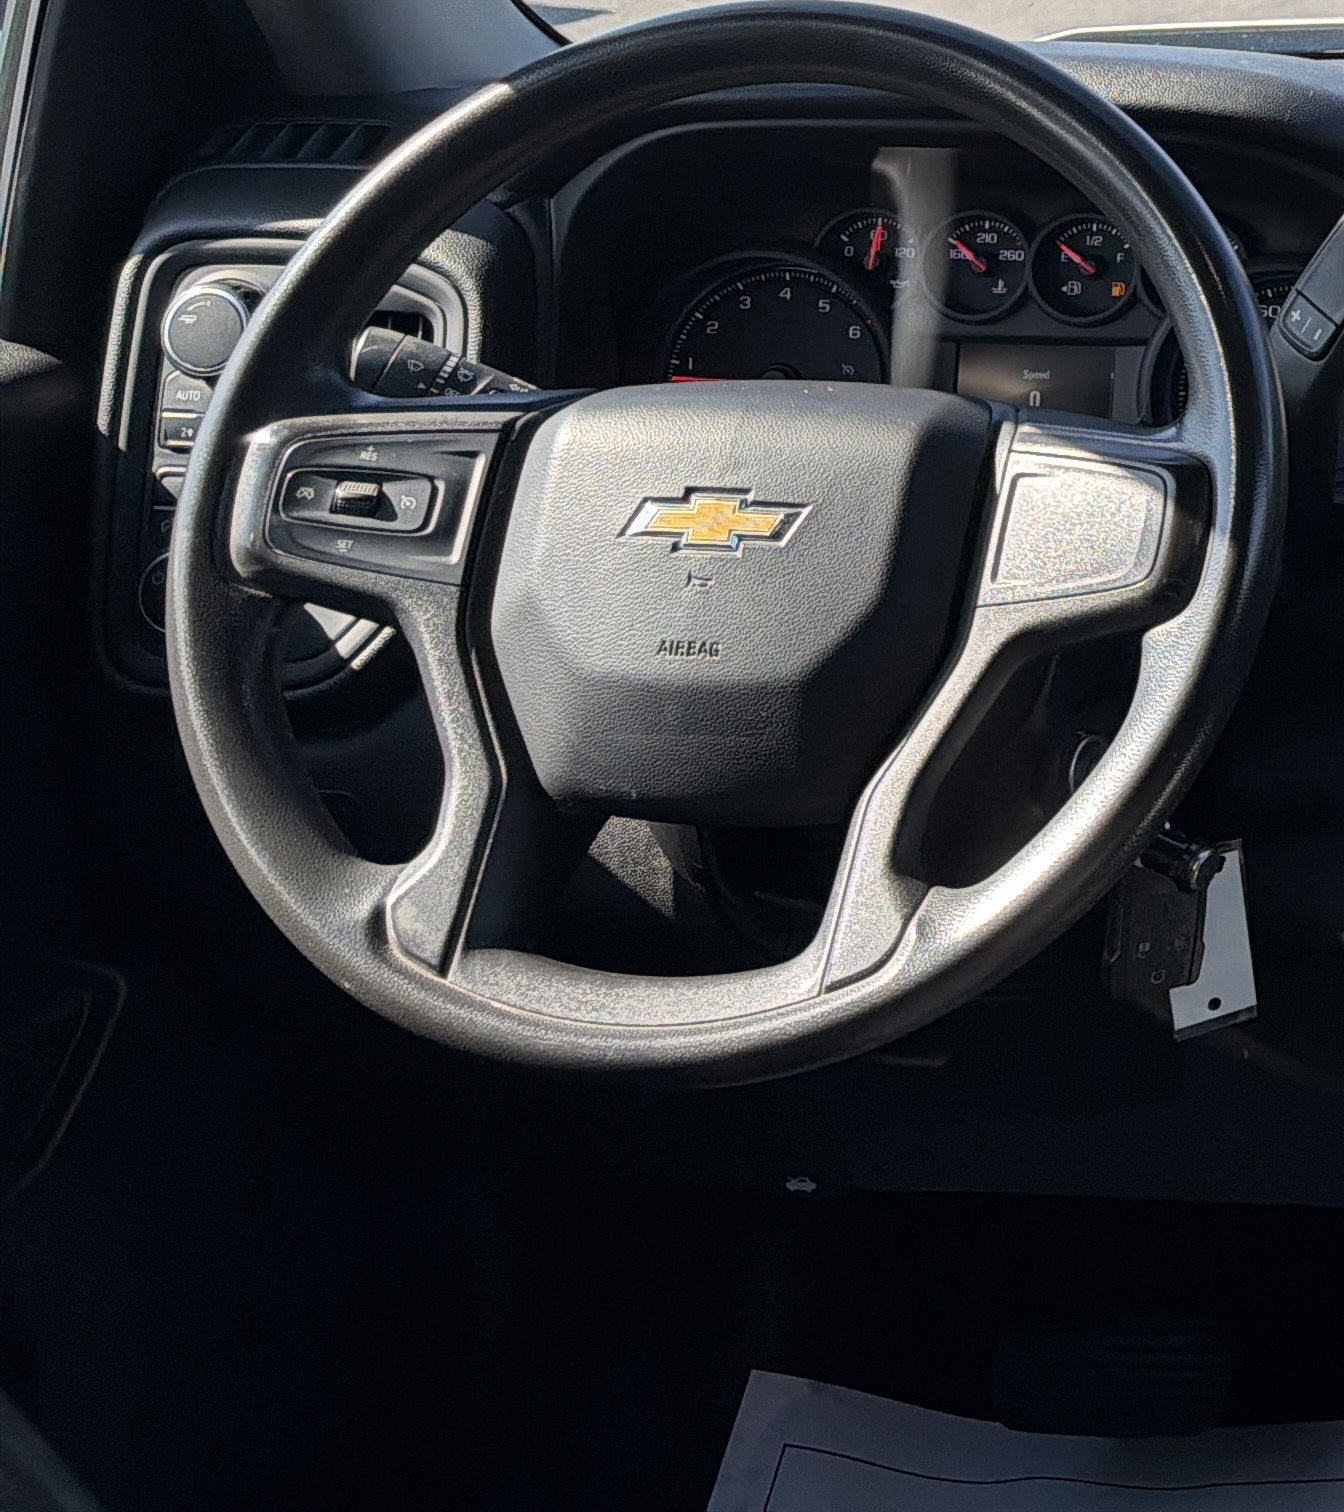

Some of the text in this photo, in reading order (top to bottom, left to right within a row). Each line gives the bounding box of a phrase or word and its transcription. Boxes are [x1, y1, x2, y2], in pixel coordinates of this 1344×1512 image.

[976, 232, 998, 244] 210
[1086, 235, 1104, 246] 1/2
[894, 247, 916, 258] 120
[999, 250, 1024, 261] 260
[1116, 253, 1125, 263] F
[778, 288, 792, 300] 4
[739, 295, 752, 310] 3
[818, 300, 831, 313] 5
[706, 320, 719, 334] 2
[848, 326, 862, 340] 6
[1023, 369, 1050, 380] Speed
[175, 390, 201, 402] AUTO
[359, 452, 378, 462] RES
[336, 540, 354, 550] SET
[655, 640, 722, 658] AIRBAG
